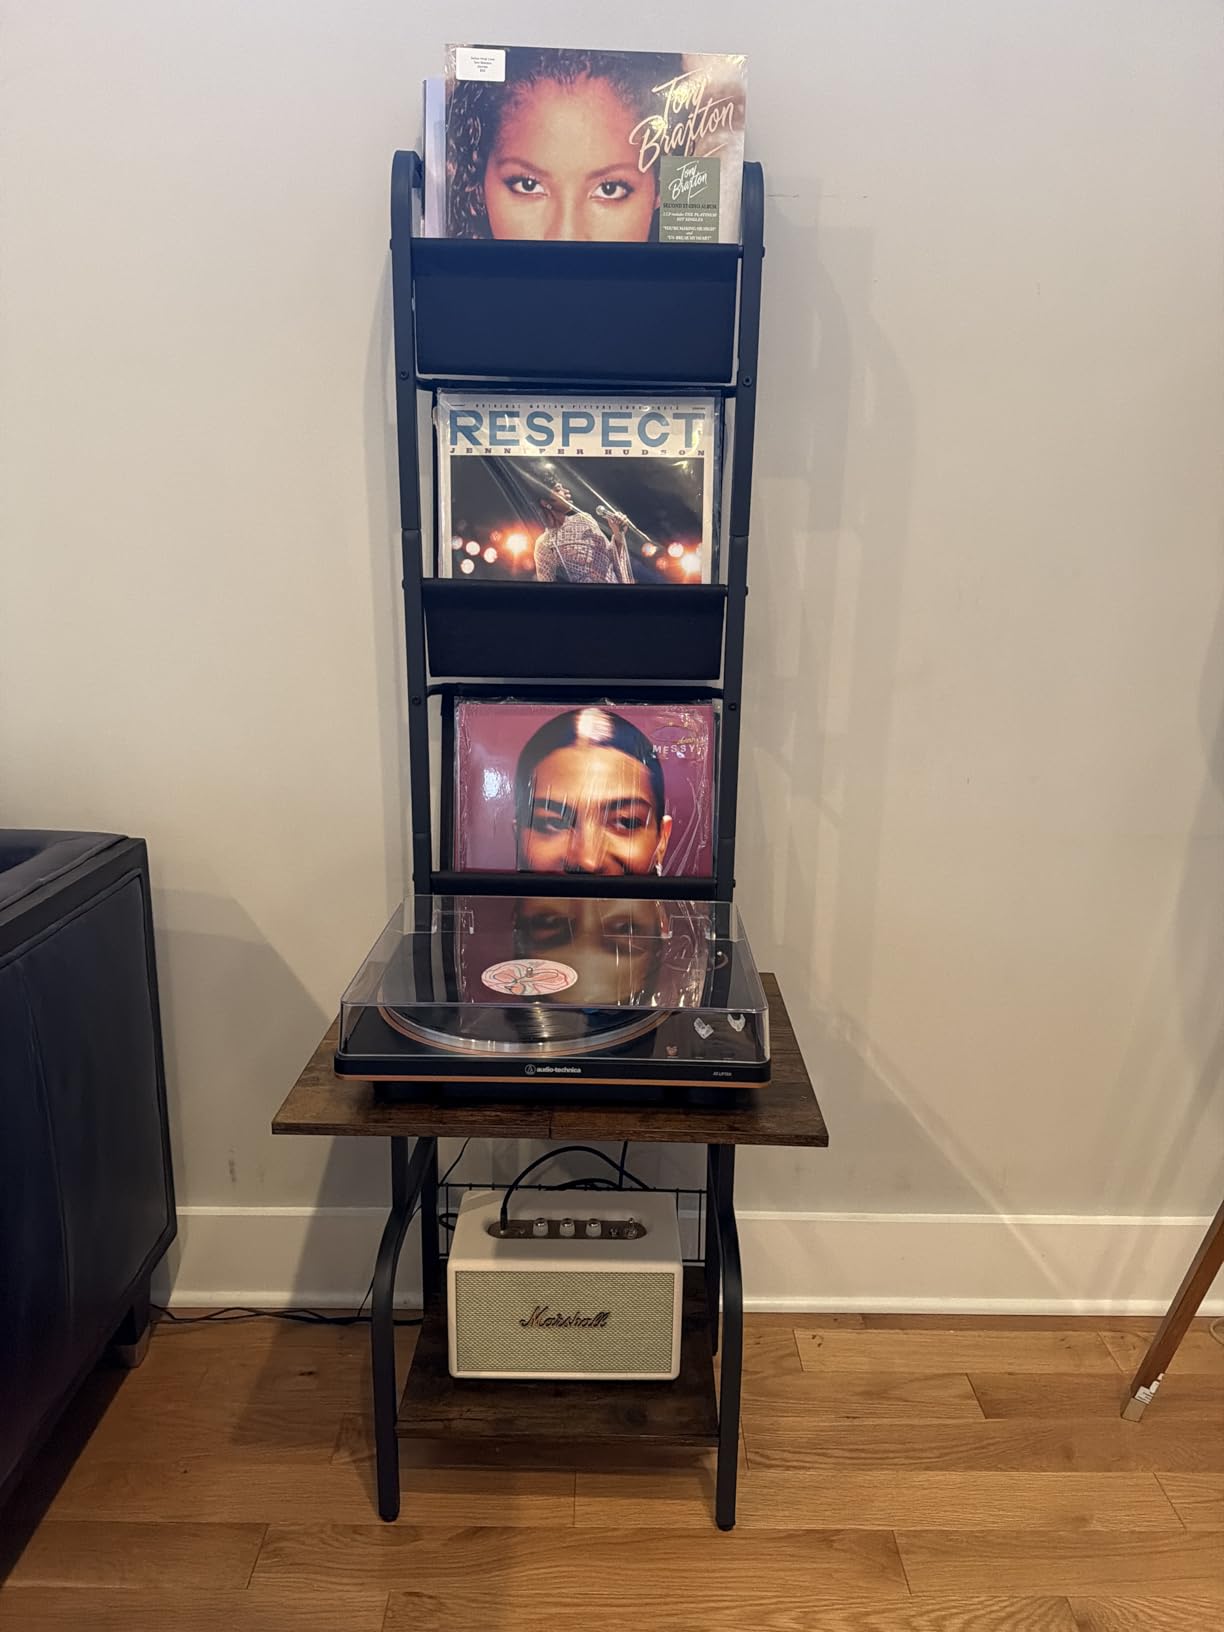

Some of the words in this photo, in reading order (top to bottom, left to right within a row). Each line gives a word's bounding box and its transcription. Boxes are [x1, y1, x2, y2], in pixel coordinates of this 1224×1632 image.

[628, 96, 735, 173] Braxton
[668, 171, 708, 204] Braxton
[449, 410, 705, 448] RESPECT
[652, 744, 695, 754] MESSY
[536, 1065, 582, 1074] audio-technica
[519, 1305, 610, 1328] Marshall
